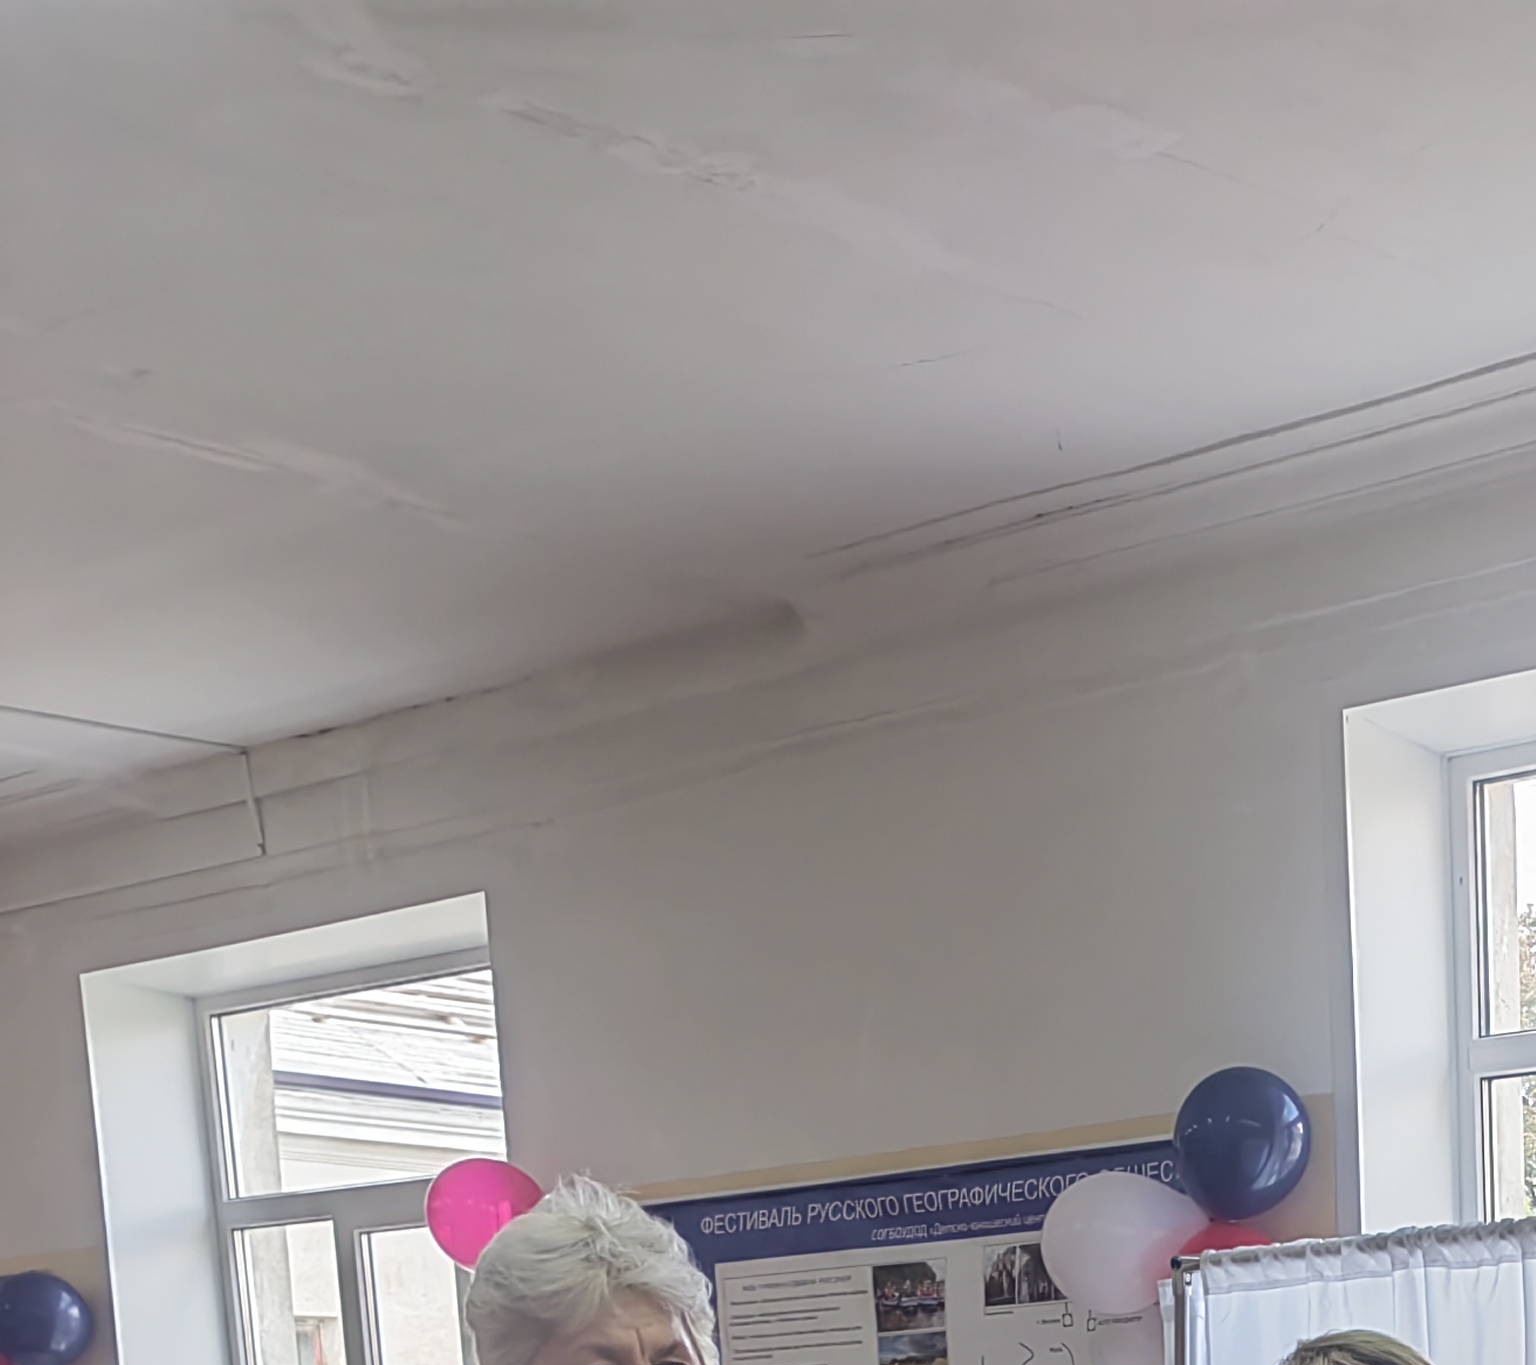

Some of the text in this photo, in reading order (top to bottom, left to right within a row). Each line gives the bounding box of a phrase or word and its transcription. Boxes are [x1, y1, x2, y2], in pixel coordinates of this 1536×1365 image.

[701, 1172, 1089, 1235] ФЕСТИВАЛЬ РУССКОГО ГЕОГРАФИЧЕСКОГ
